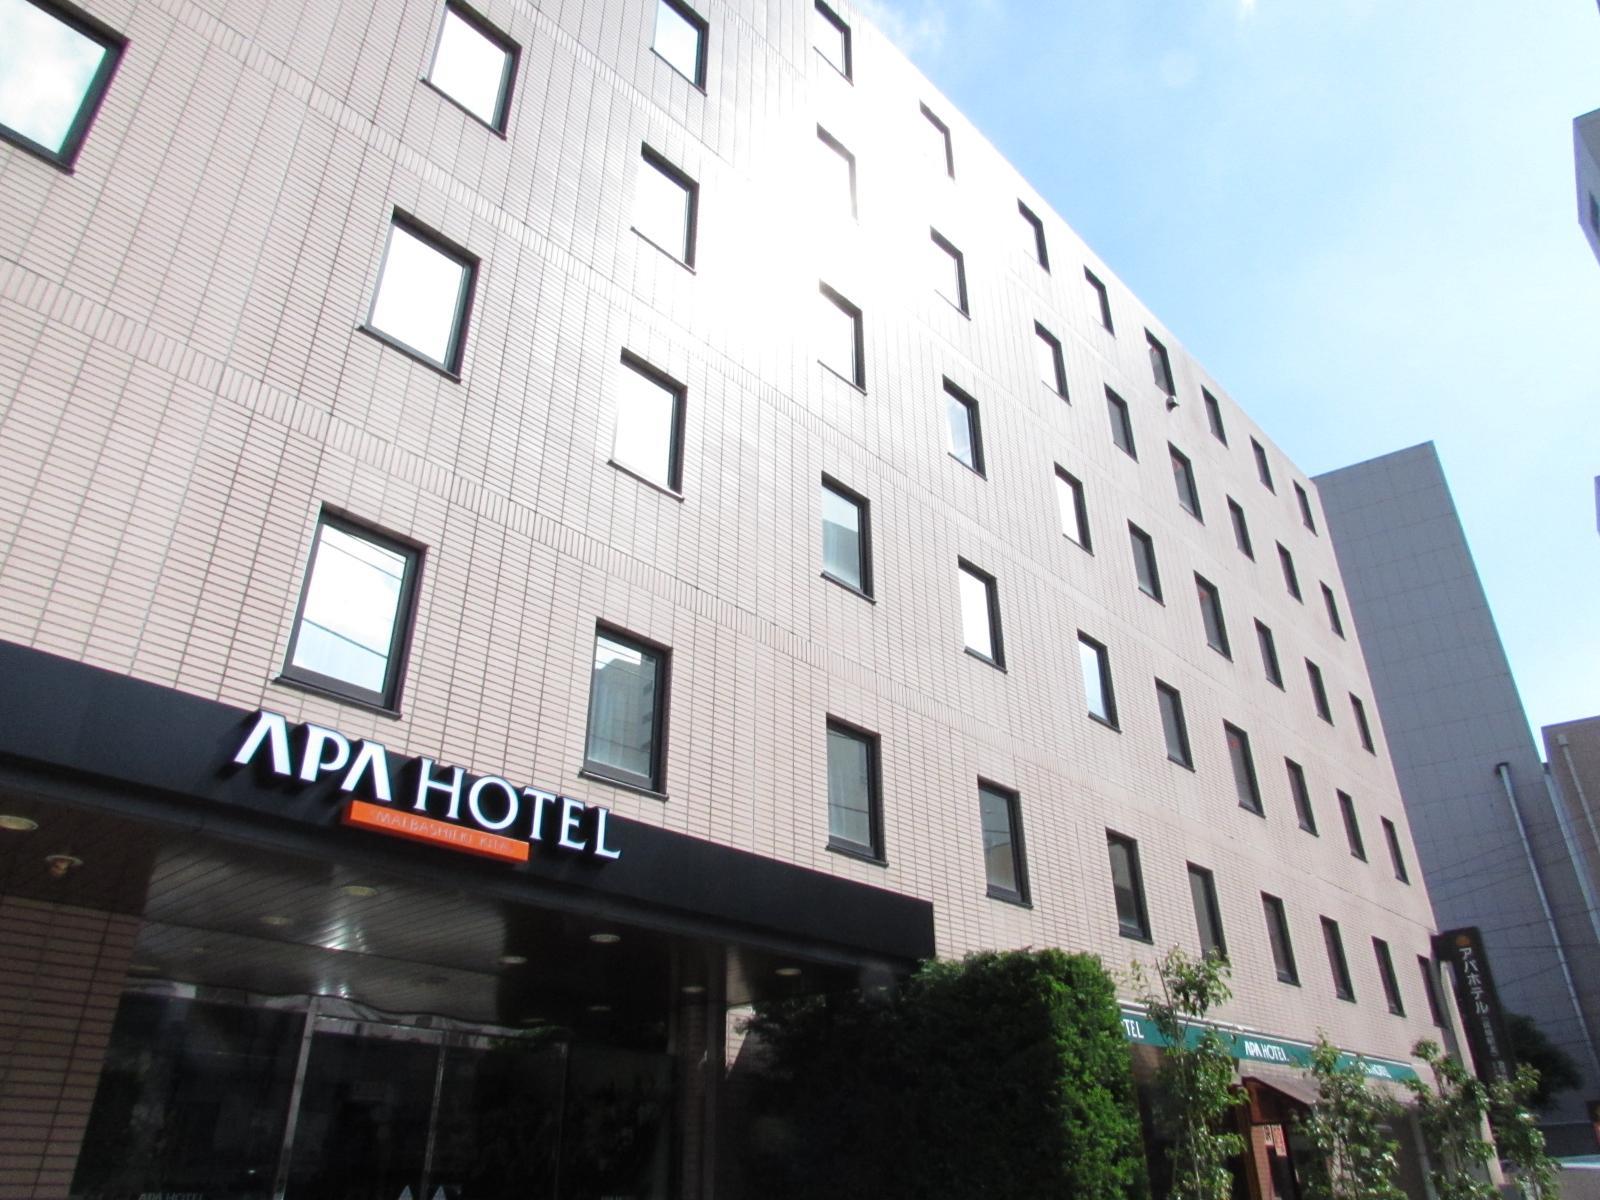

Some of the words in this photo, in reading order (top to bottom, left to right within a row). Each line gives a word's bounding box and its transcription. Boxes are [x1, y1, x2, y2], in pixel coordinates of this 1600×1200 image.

[234, 710, 393, 802] APA
[413, 757, 621, 860] HOTEL
[1121, 1018, 1145, 1039] TEL
[1261, 1044, 1288, 1062] HOTEL
